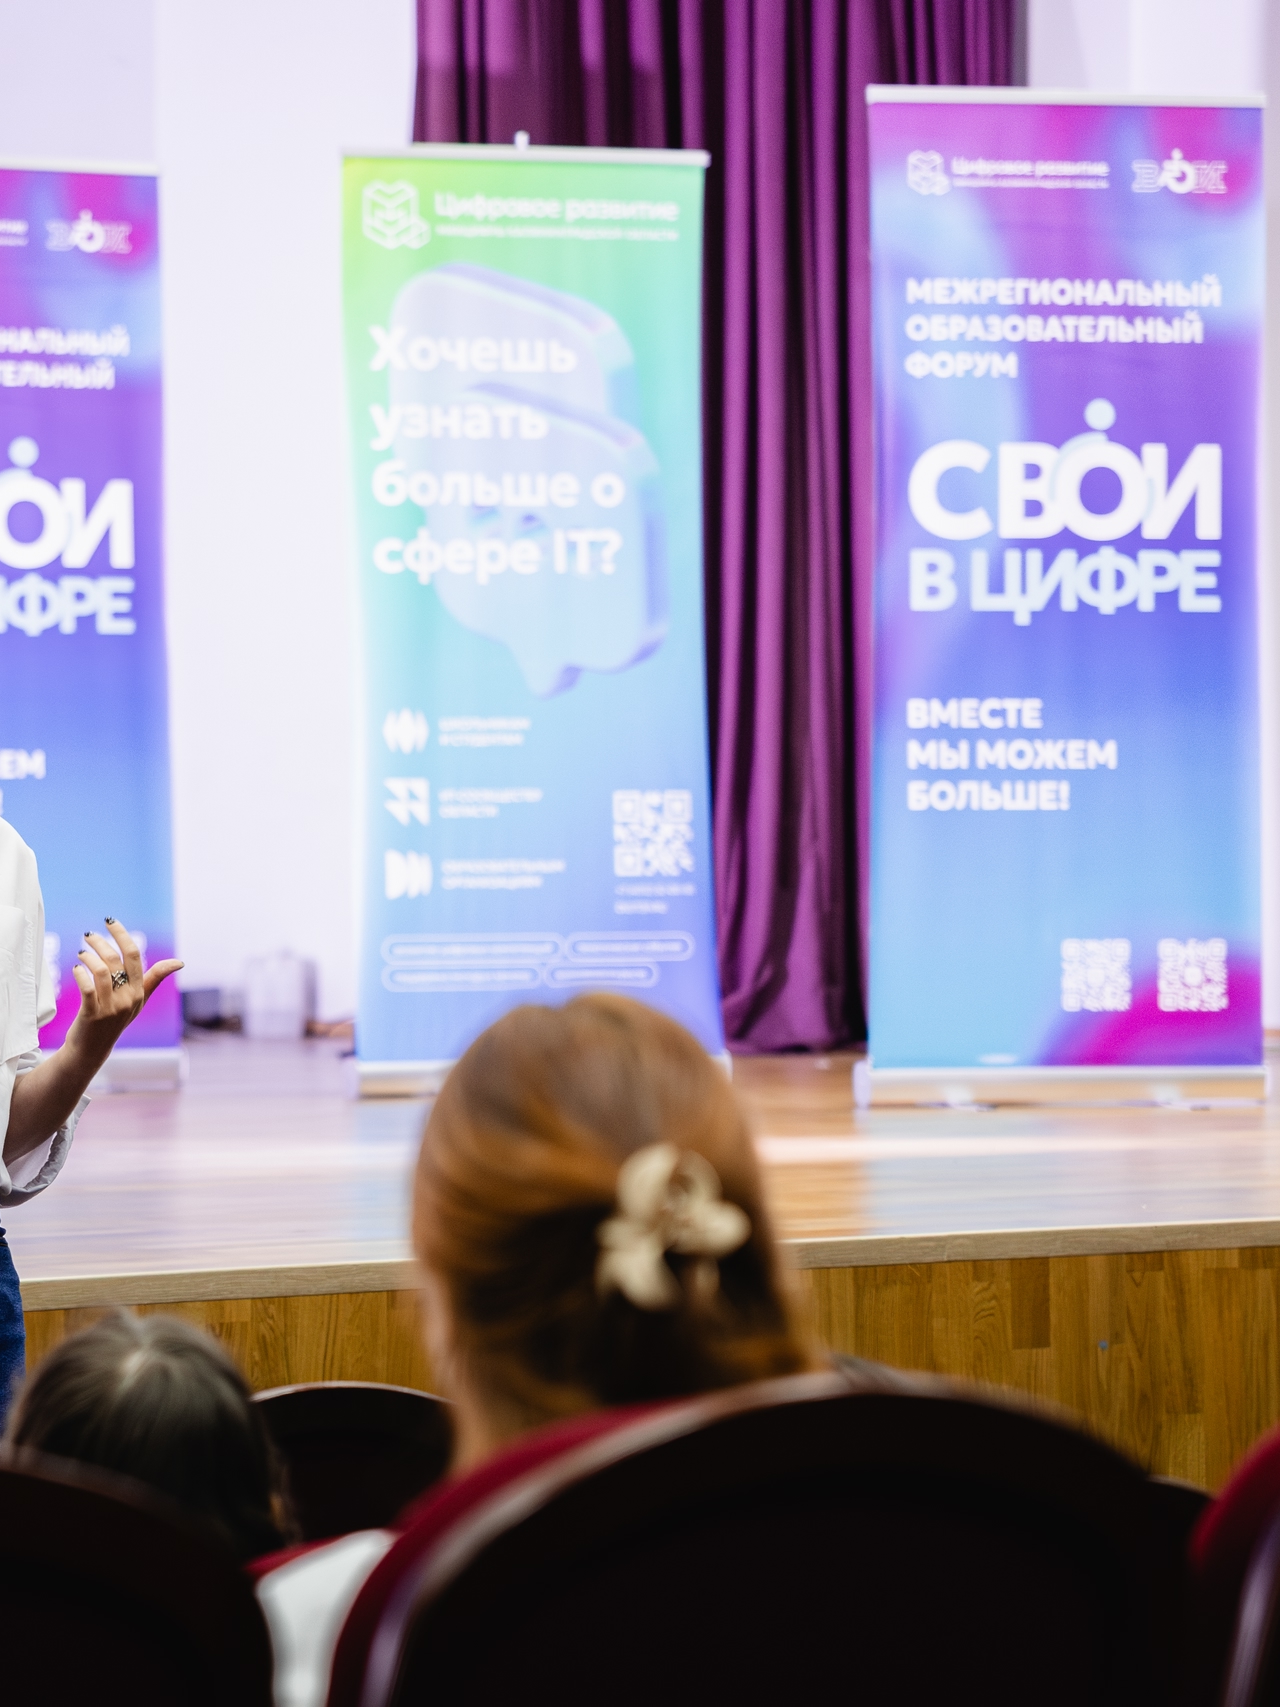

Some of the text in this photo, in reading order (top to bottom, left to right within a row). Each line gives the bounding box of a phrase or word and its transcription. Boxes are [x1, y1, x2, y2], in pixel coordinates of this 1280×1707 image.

[435, 192, 680, 223] Цифровое развитие
[905, 274, 1222, 307] МЕЖРЕГИОНАЛЬНЫЙ
[904, 310, 1204, 343] ОБРАЗОВАТЕЛЬНЫЙ
[368, 325, 578, 373] Хочешь
[904, 350, 1019, 379] ФОРУМ
[369, 403, 549, 451] узнать
[372, 459, 626, 508] больше о
[907, 432, 1223, 541] СВОИ
[372, 527, 623, 586] сфере IT?
[909, 545, 1222, 627] В ЦИФРЕ
[906, 697, 1044, 730] ВМЕСТЕ
[906, 738, 1118, 771] МЫ МОЖЕМ
[906, 780, 1071, 812] БОЛЬШЕ!
